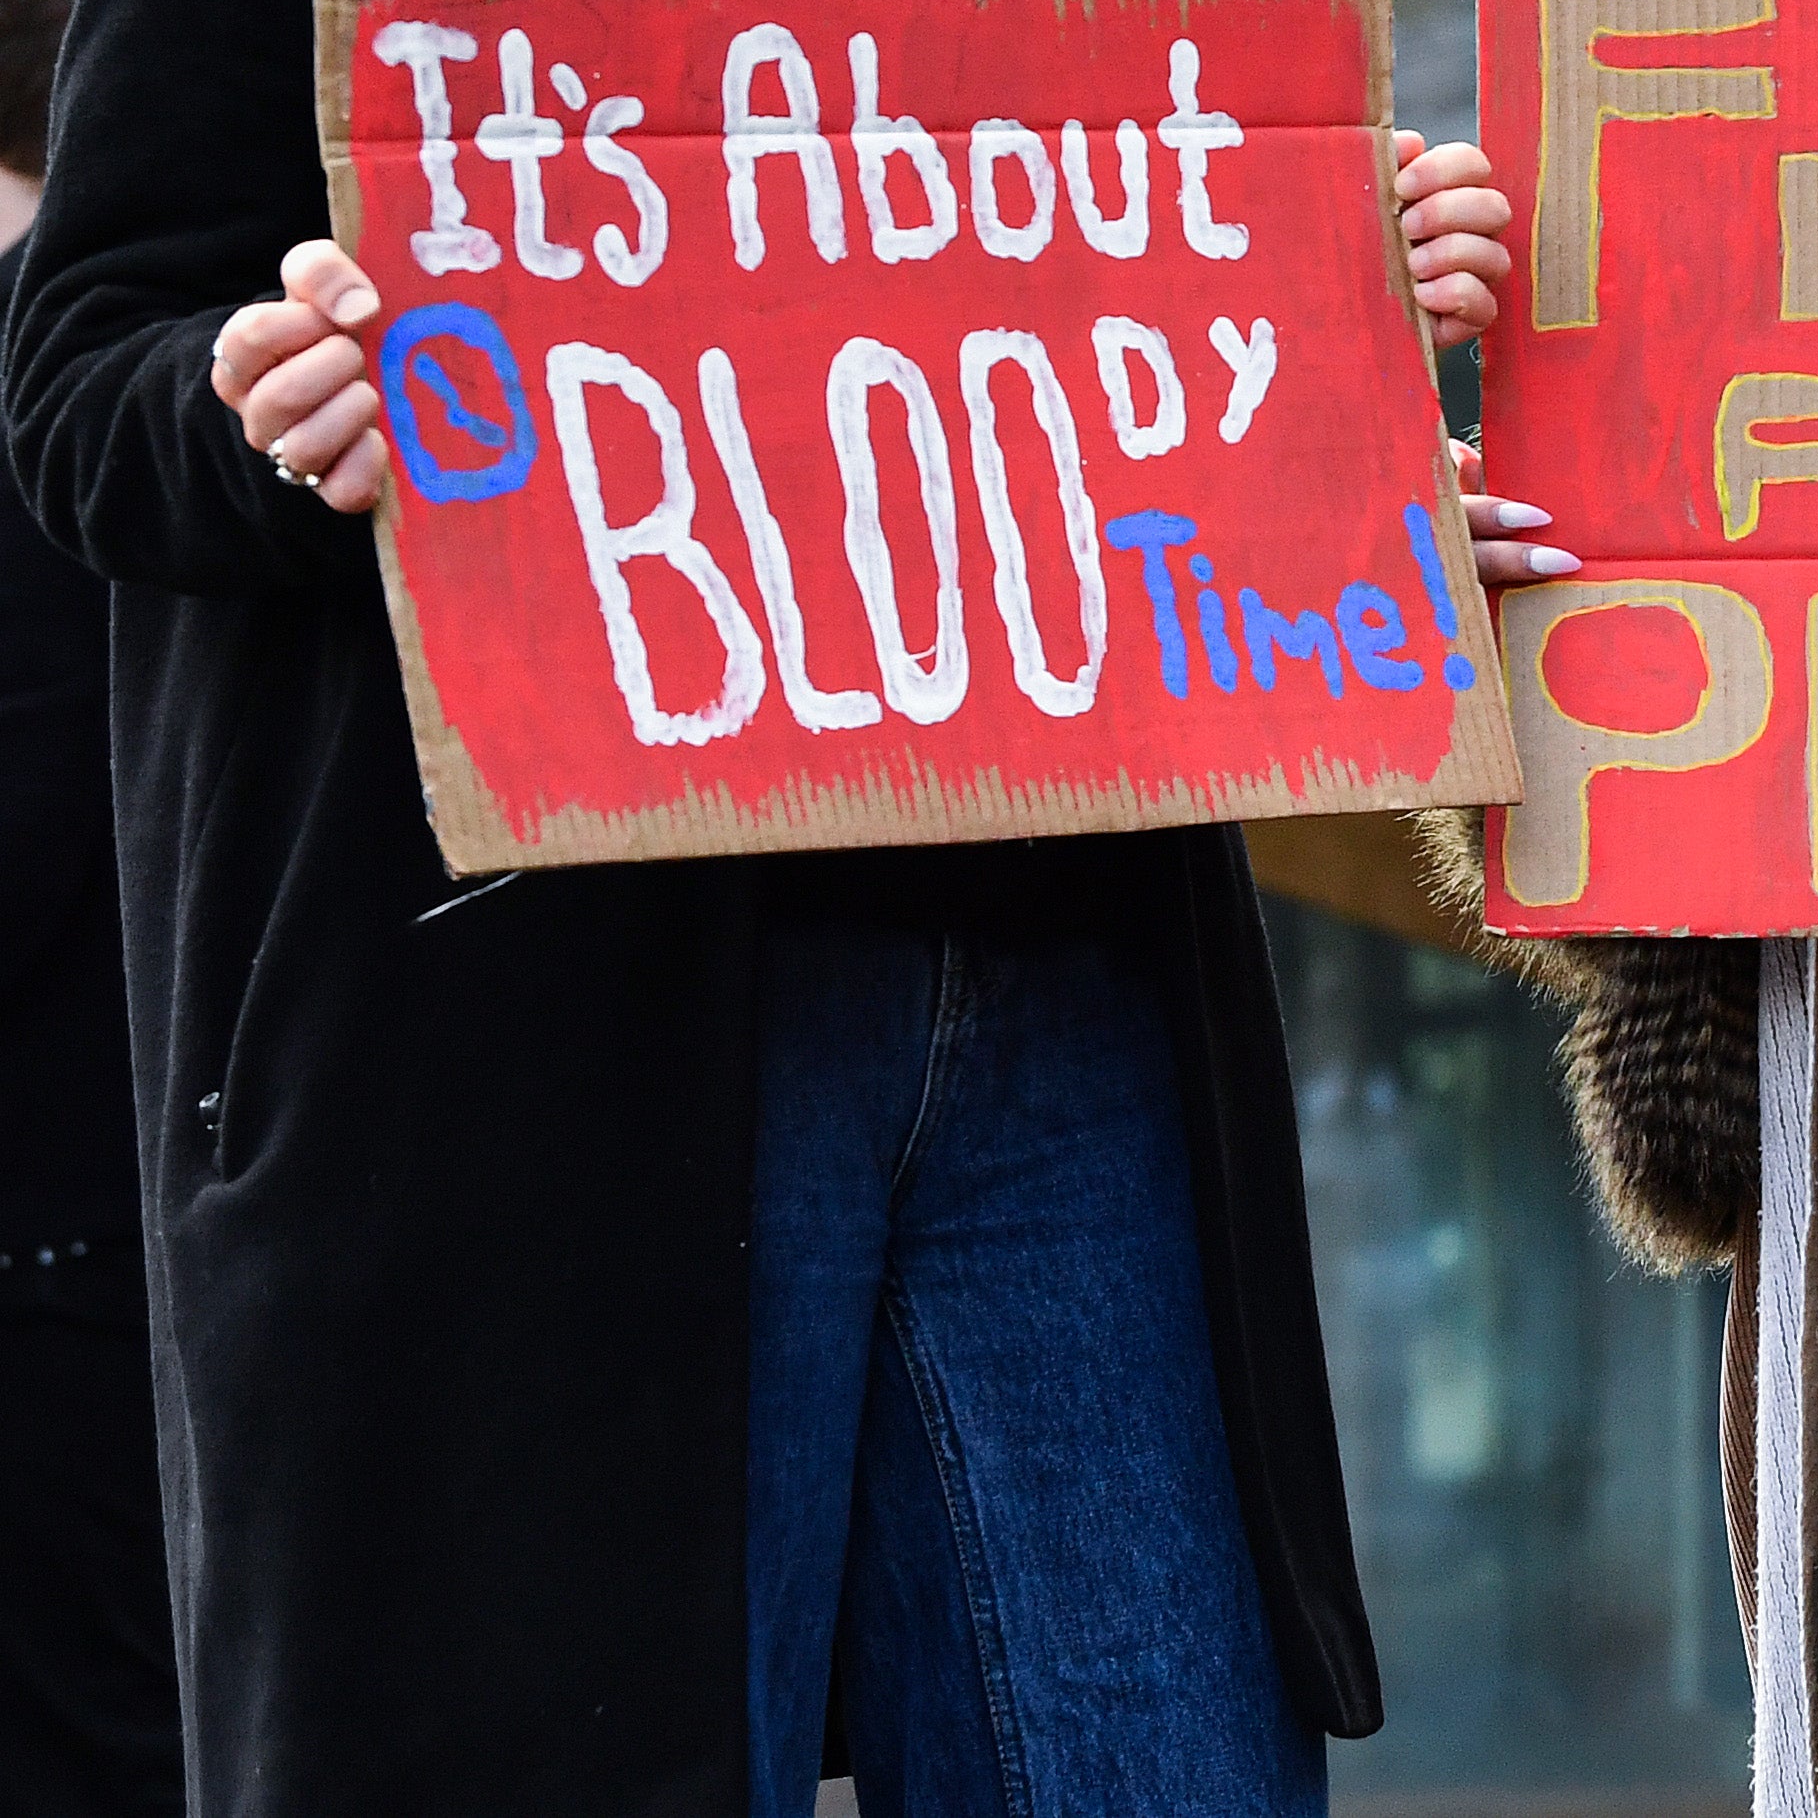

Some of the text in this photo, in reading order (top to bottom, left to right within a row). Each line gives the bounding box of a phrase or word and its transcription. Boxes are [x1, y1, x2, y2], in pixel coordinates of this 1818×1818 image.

[373, 21, 1249, 286] It's About
[1107, 503, 1475, 698] Time!
